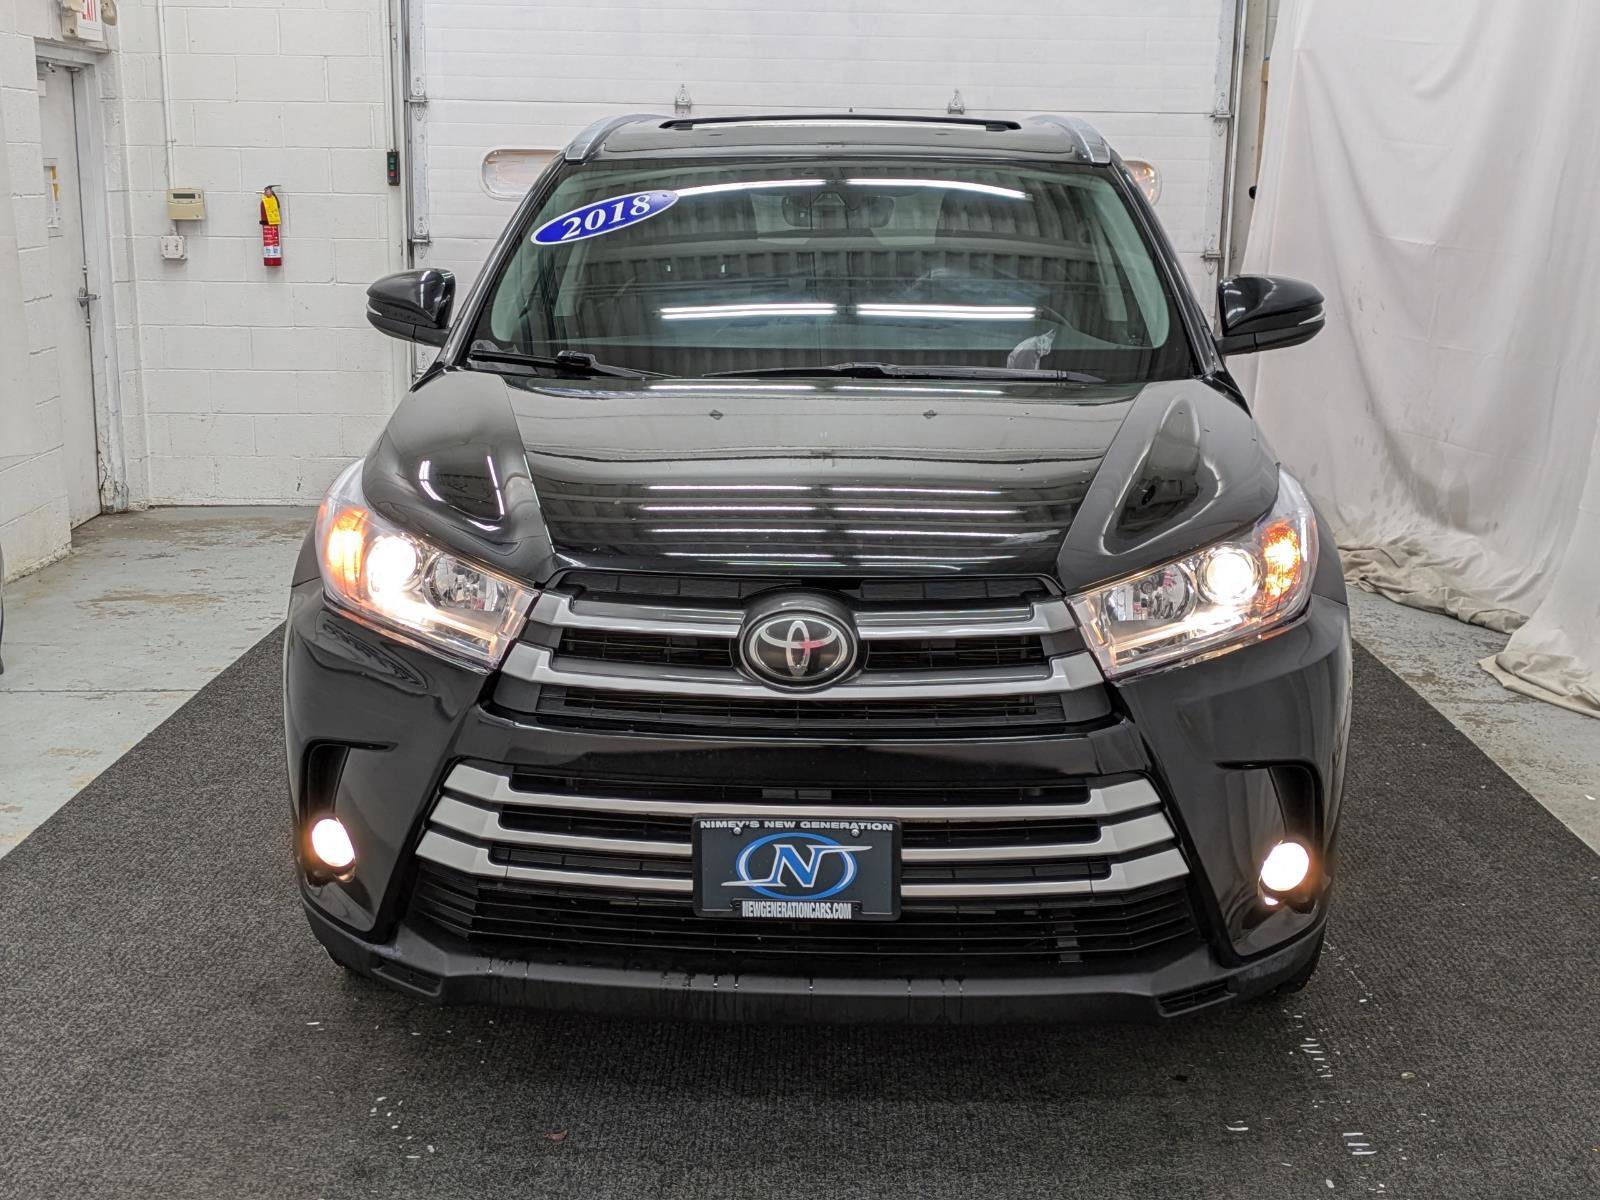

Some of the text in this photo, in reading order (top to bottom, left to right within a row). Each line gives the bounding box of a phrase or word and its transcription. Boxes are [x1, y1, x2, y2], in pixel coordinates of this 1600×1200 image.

[561, 194, 650, 240] 2018
[700, 820, 893, 830] NIMEY'S NEW GENERATION
[742, 901, 851, 919] NEWGENERATIONCARS.COM
